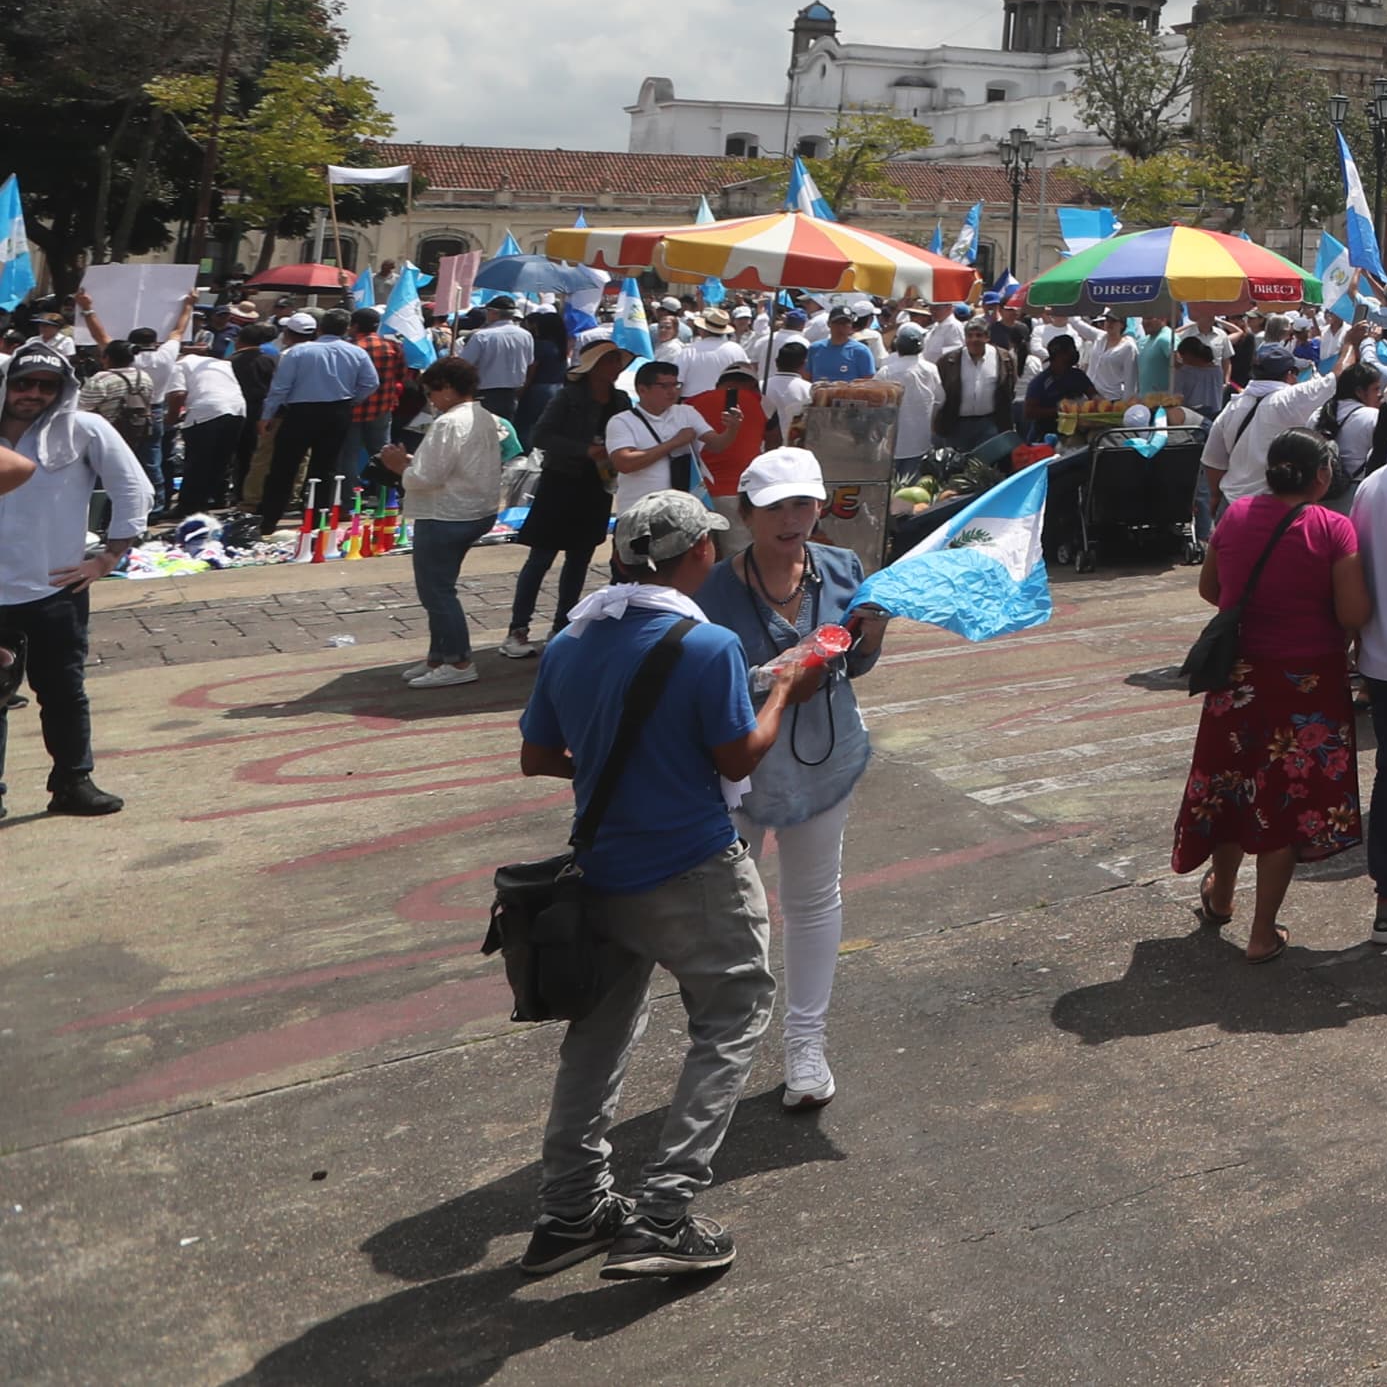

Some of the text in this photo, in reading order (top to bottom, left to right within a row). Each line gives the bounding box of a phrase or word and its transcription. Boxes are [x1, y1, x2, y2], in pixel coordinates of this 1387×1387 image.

[1093, 284, 1153, 295] DIRECT
[1253, 283, 1296, 295] DIRECT
[19, 354, 62, 367] PING
